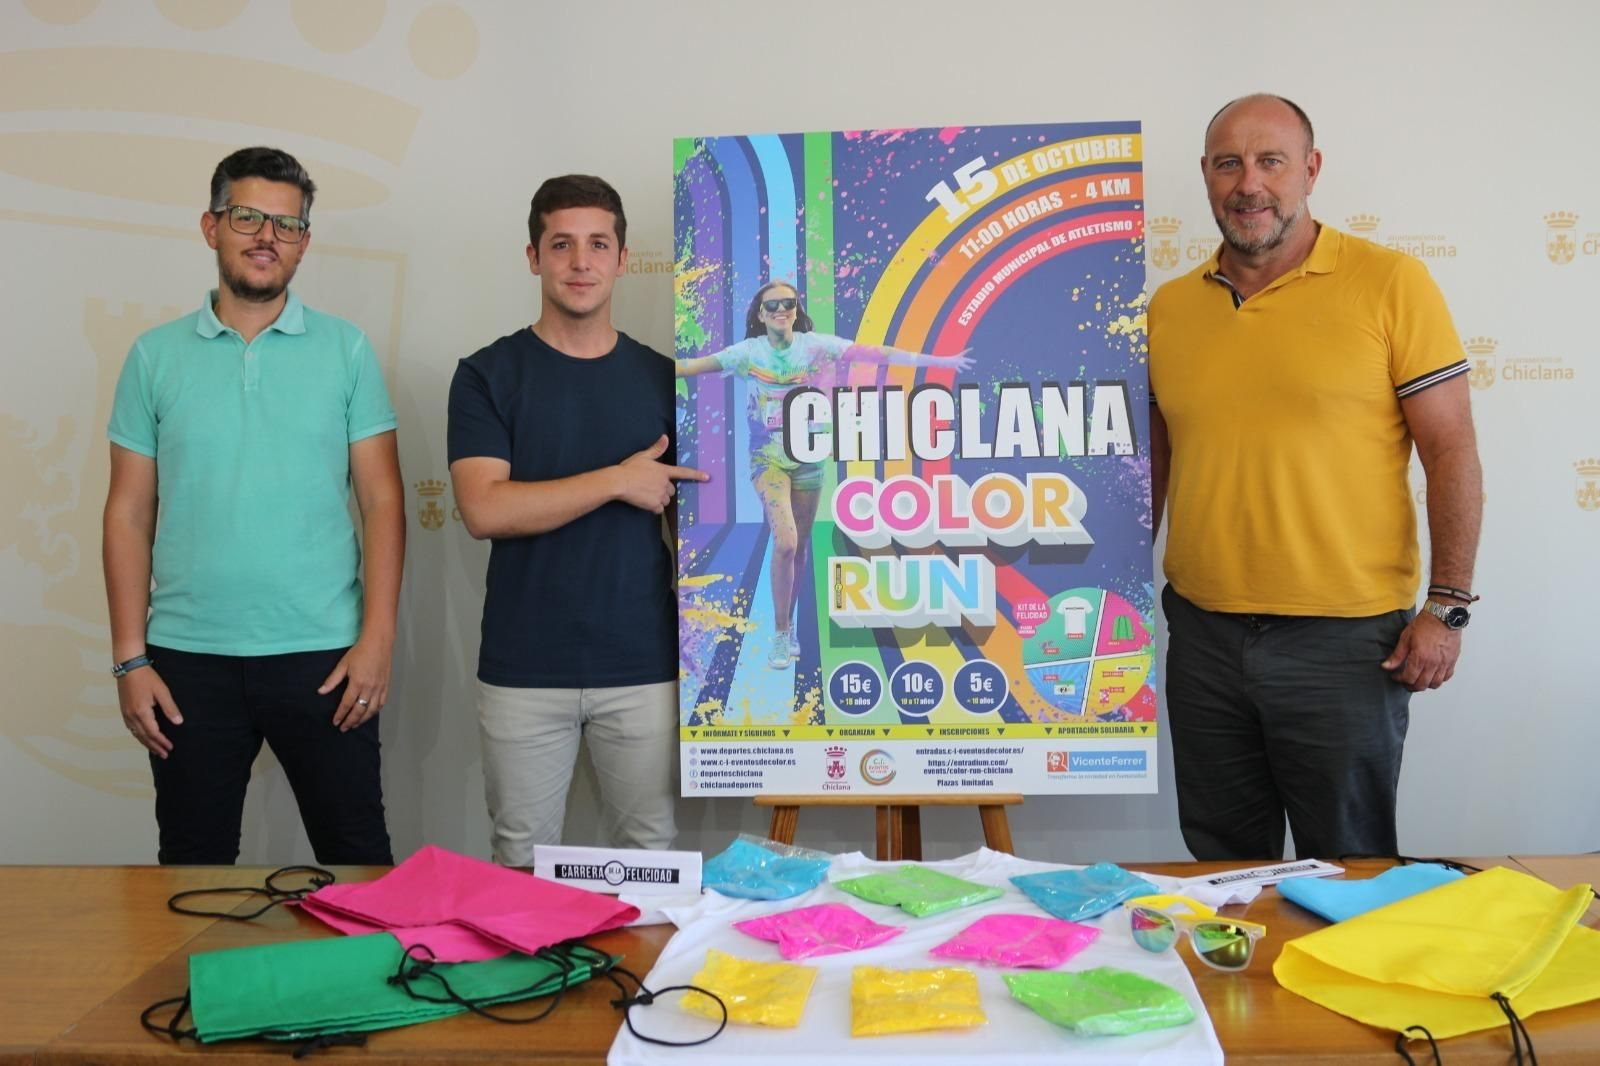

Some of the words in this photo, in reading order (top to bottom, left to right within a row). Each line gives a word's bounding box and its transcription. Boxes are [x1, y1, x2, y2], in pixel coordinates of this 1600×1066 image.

[925, 156, 999, 224] 15
[1001, 164, 1031, 185] DE
[1031, 137, 1133, 173] OCTUBRE
[959, 225, 1004, 260] 11:00
[1002, 191, 1064, 230] HORAS
[1086, 182, 1098, 199] 4
[1101, 178, 1131, 196] KM
[958, 281, 996, 327] ESTADIO
[992, 243, 1051, 286] MUNICIPAL
[1051, 234, 1068, 247] DE
[1068, 220, 1133, 241] ATLETISMO
[1502, 364, 1575, 381] Chiclana
[784, 382, 1138, 464] CHICLANA
[834, 474, 1076, 536] COLOR
[831, 556, 984, 616] RUN
[1017, 603, 1028, 611] KIT
[1029, 603, 1037, 611] DE
[1037, 603, 1046, 611] LA
[1016, 611, 1048, 620] FELICIDAD
[839, 673, 872, 694] 15€
[902, 672, 934, 693] 10€
[970, 672, 993, 693] 5€
[854, 696, 871, 706] años
[919, 696, 935, 705] años
[979, 696, 994, 705] años
[703, 729, 737, 738] INFÓRMATE
[744, 728, 776, 737] SÍGUENOS
[839, 729, 876, 737] ORGANIZAN
[939, 727, 990, 736] INSCRIPCIONES
[1058, 725, 1099, 735] APORTACIÓN
[1100, 726, 1135, 735] SOLIDARIA
[700, 747, 794, 756] www.deportes.chiclana.es
[700, 758, 796, 766] www.c-i-eventosdecolor.es
[928, 759, 1008, 768] https://entradium.com/
[1072, 756, 1144, 767] VicenteFerrer
[700, 769, 763, 778] deporteschiclana
[923, 767, 1014, 775] events/color-run-chiclana
[700, 781, 763, 790] chiclanadeportes
[822, 783, 851, 791] Chiclana
[937, 779, 959, 787] Plazas
[961, 779, 994, 787] limitadas
[561, 865, 605, 879] CARRERA
[625, 868, 673, 883] FELICIDAD
